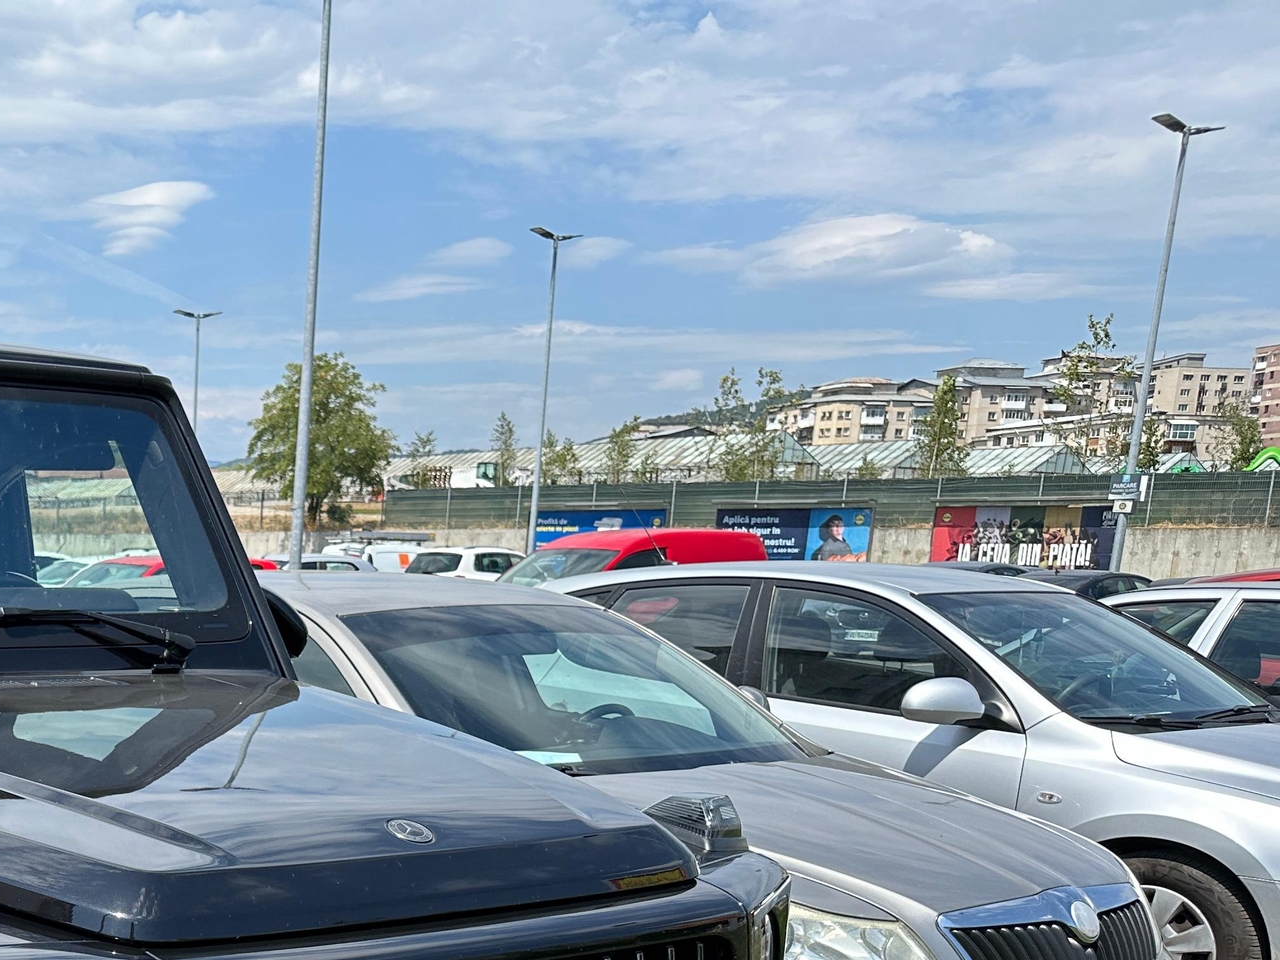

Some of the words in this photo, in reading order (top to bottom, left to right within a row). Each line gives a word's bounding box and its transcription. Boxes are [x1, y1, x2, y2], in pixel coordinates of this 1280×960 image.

[723, 515, 750, 526] Aplică
[751, 516, 780, 526] pentru
[764, 538, 795, 546] nostru!
[957, 543, 970, 562] IA
[978, 542, 1011, 563] CEVA
[1018, 543, 1042, 566] DIN
